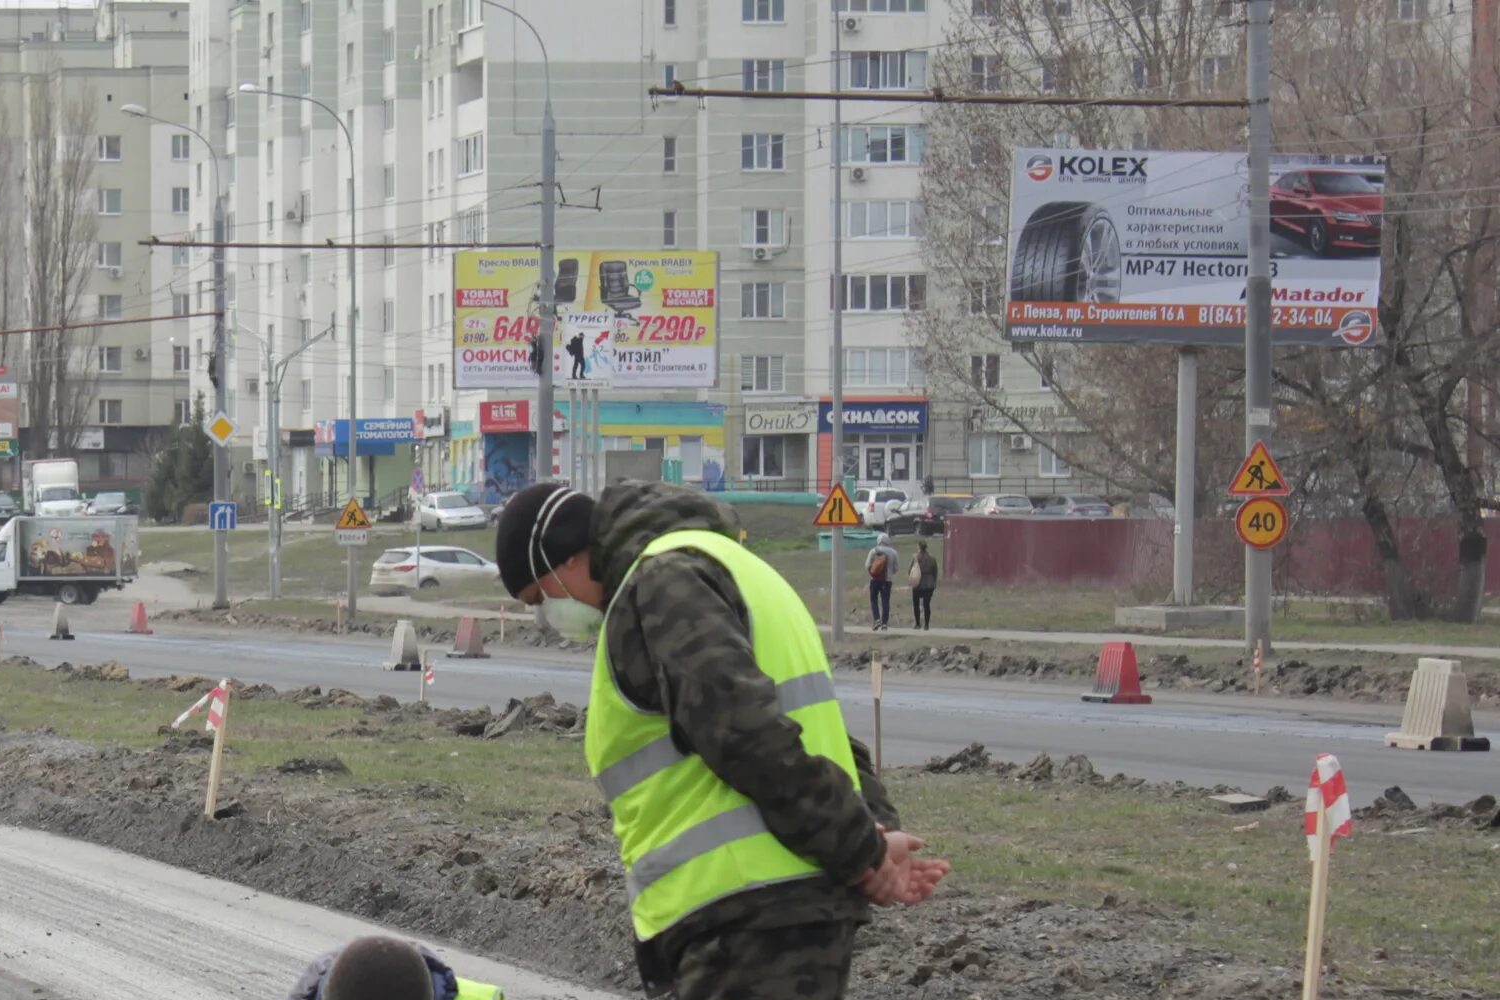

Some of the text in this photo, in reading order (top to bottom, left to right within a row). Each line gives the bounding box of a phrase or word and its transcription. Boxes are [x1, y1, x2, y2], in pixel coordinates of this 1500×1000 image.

[1060, 156, 1148, 176] KOLEX
[1127, 204, 1213, 217] Оптимальные
[1126, 223, 1224, 235] характеристики
[1137, 239, 1180, 249] любых
[1183, 241, 1240, 252] условиях
[513, 259, 540, 267] BRABI
[1125, 260, 1177, 276] MP47
[1183, 260, 1249, 277] Hectorr
[1271, 287, 1364, 302] Matador
[567, 314, 610, 324] ТУРИСТ
[1011, 306, 1020, 318] г.
[1024, 304, 1063, 320] Пенза,
[1067, 306, 1085, 322] пр.
[1088, 305, 1157, 323] Строителей
[1161, 306, 1174, 321] 16
[1011, 323, 1083, 338] www.kolex.ru
[462, 349, 529, 363] ОФИСМ
[485, 365, 533, 373] ГИПЕРМАРК
[826, 410, 920, 424] ОКНА СОК
[363, 420, 412, 431] СЕМЕЙНАЯ
[1248, 512, 1276, 532] 40
